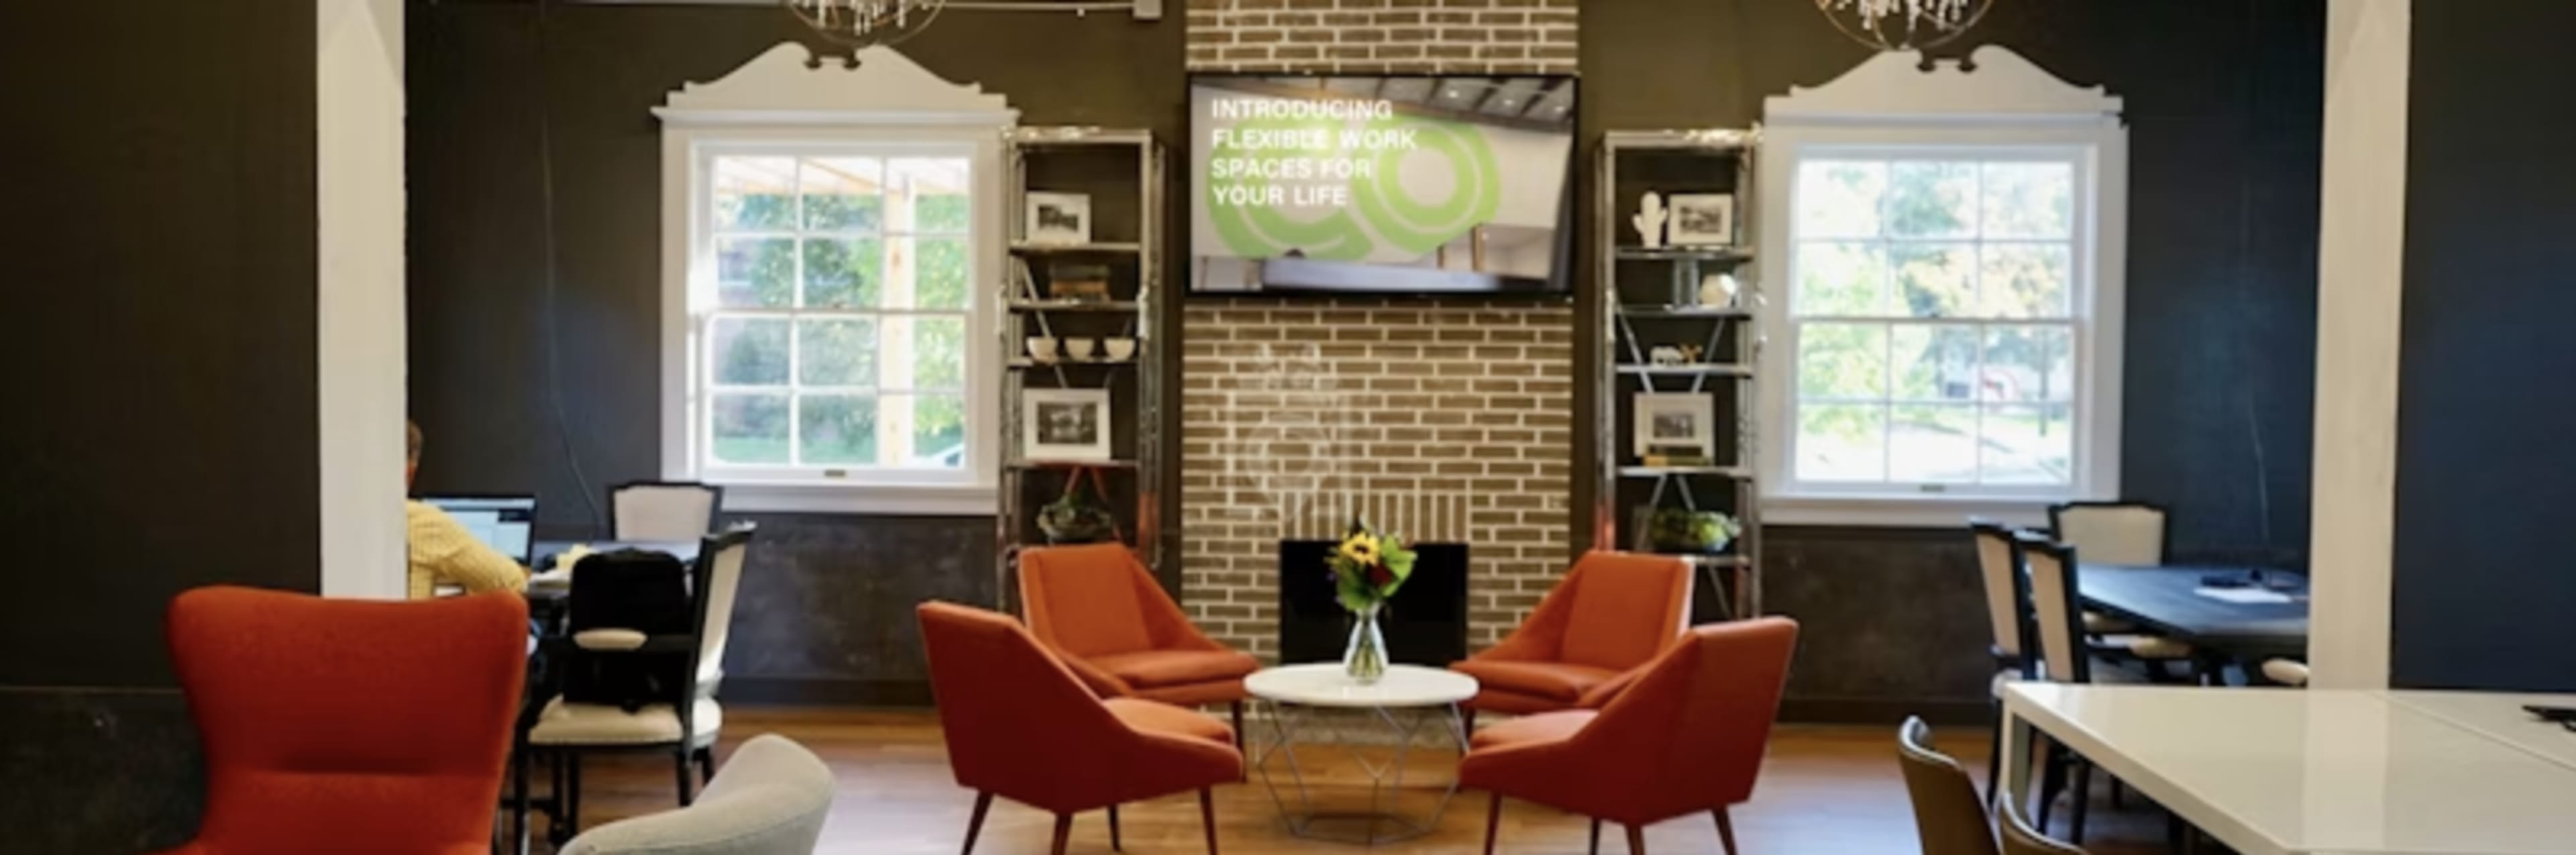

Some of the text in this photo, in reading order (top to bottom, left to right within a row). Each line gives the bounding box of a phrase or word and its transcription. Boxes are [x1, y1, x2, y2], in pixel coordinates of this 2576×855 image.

[1212, 99, 1393, 119] INTRODUCING
[1212, 130, 1417, 150] FLEXIBLE WORK
[1212, 158, 1371, 179] SPACES FOR
[1213, 187, 1348, 205] YOUR LIFE
